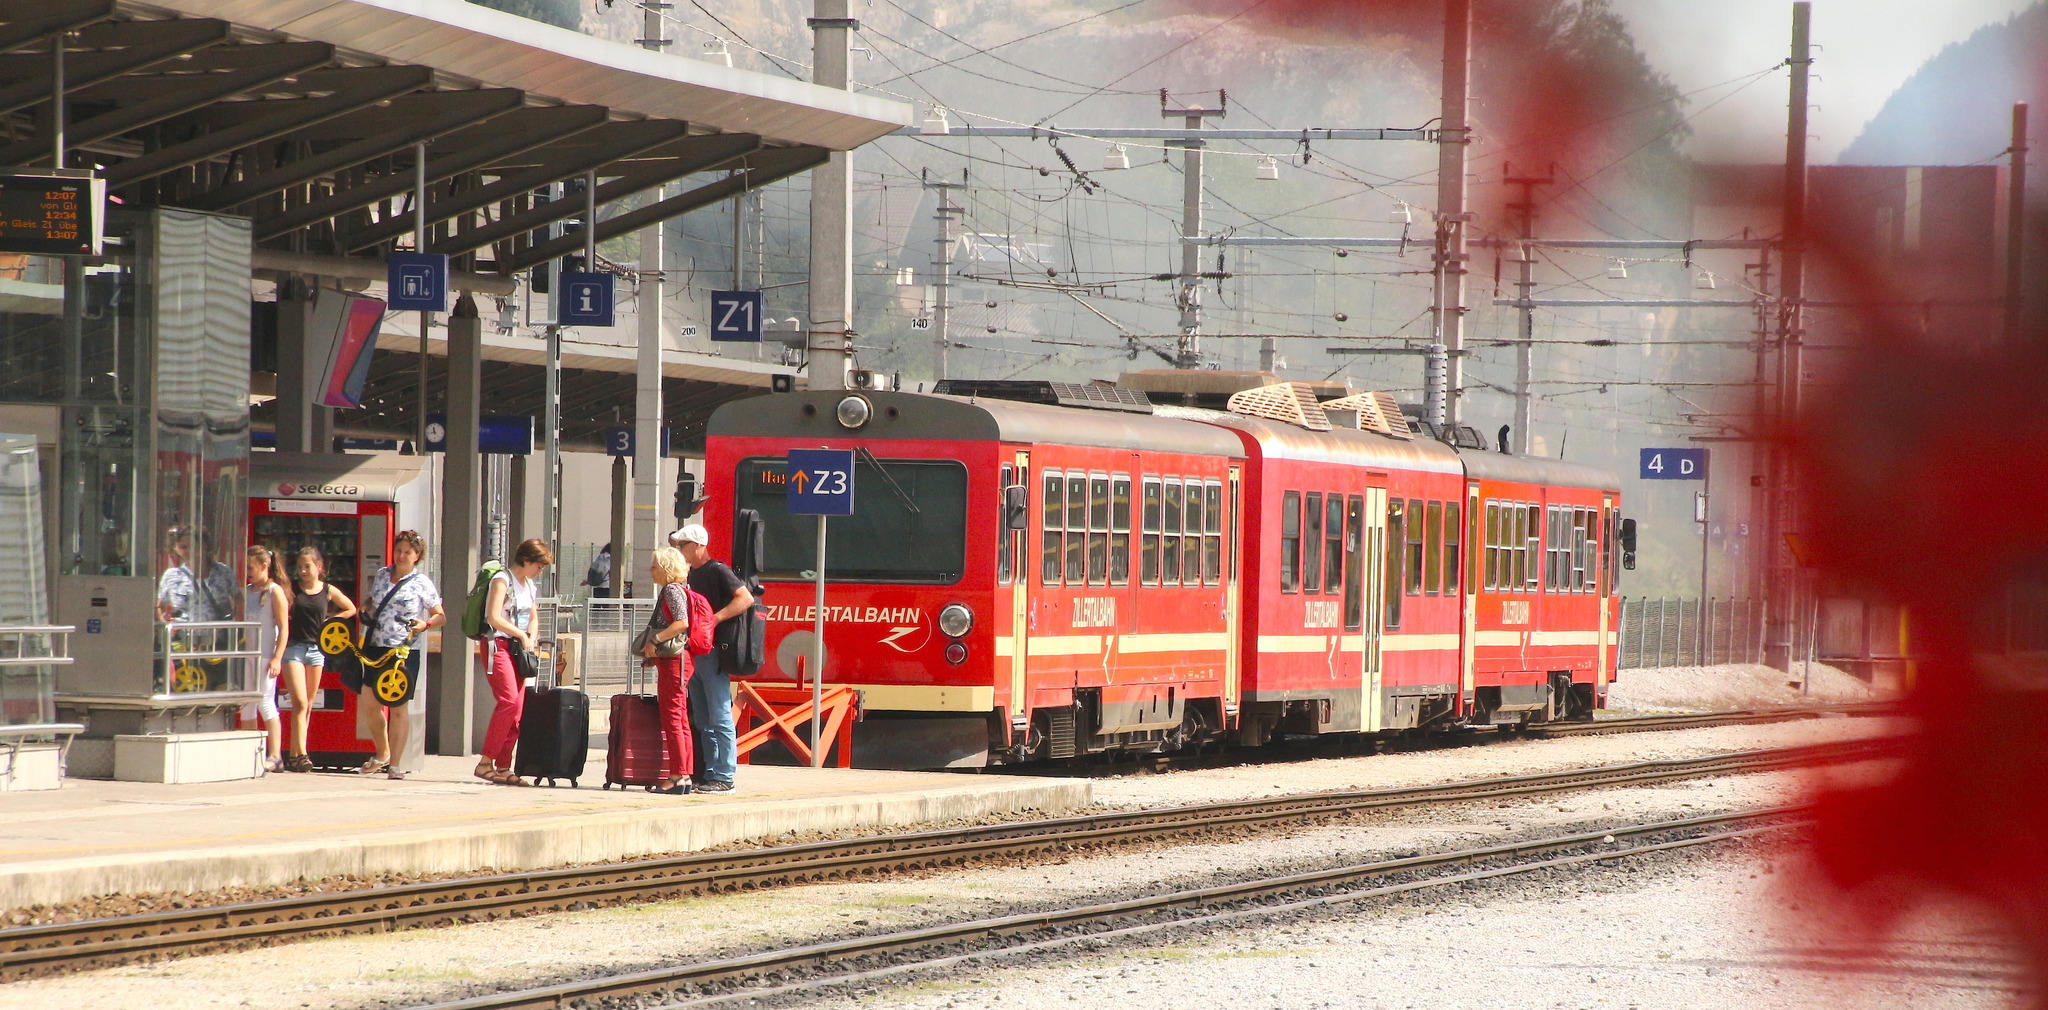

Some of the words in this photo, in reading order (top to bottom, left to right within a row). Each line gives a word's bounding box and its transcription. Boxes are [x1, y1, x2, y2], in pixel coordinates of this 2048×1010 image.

[45, 191, 76, 200] 12:07
[41, 202, 58, 210] von
[45, 211, 76, 220] 12:34
[12, 219, 36, 228] Gleis
[46, 231, 77, 239] 13:07
[717, 300, 753, 332] Z1
[912, 318, 928, 328] 140
[681, 327, 696, 336] 200
[616, 431, 629, 451] 3
[1647, 453, 1664, 474] 4
[1680, 458, 1694, 475] D
[298, 483, 358, 495] selecta
[812, 470, 848, 495] Z3
[766, 605, 920, 623] ZILLERTALBAHN
[1072, 597, 1115, 628] ZILLERTALBAHN
[1304, 601, 1339, 628] ZILLERTALBAHN
[1502, 601, 1530, 624] ZILLERTALBAHN
